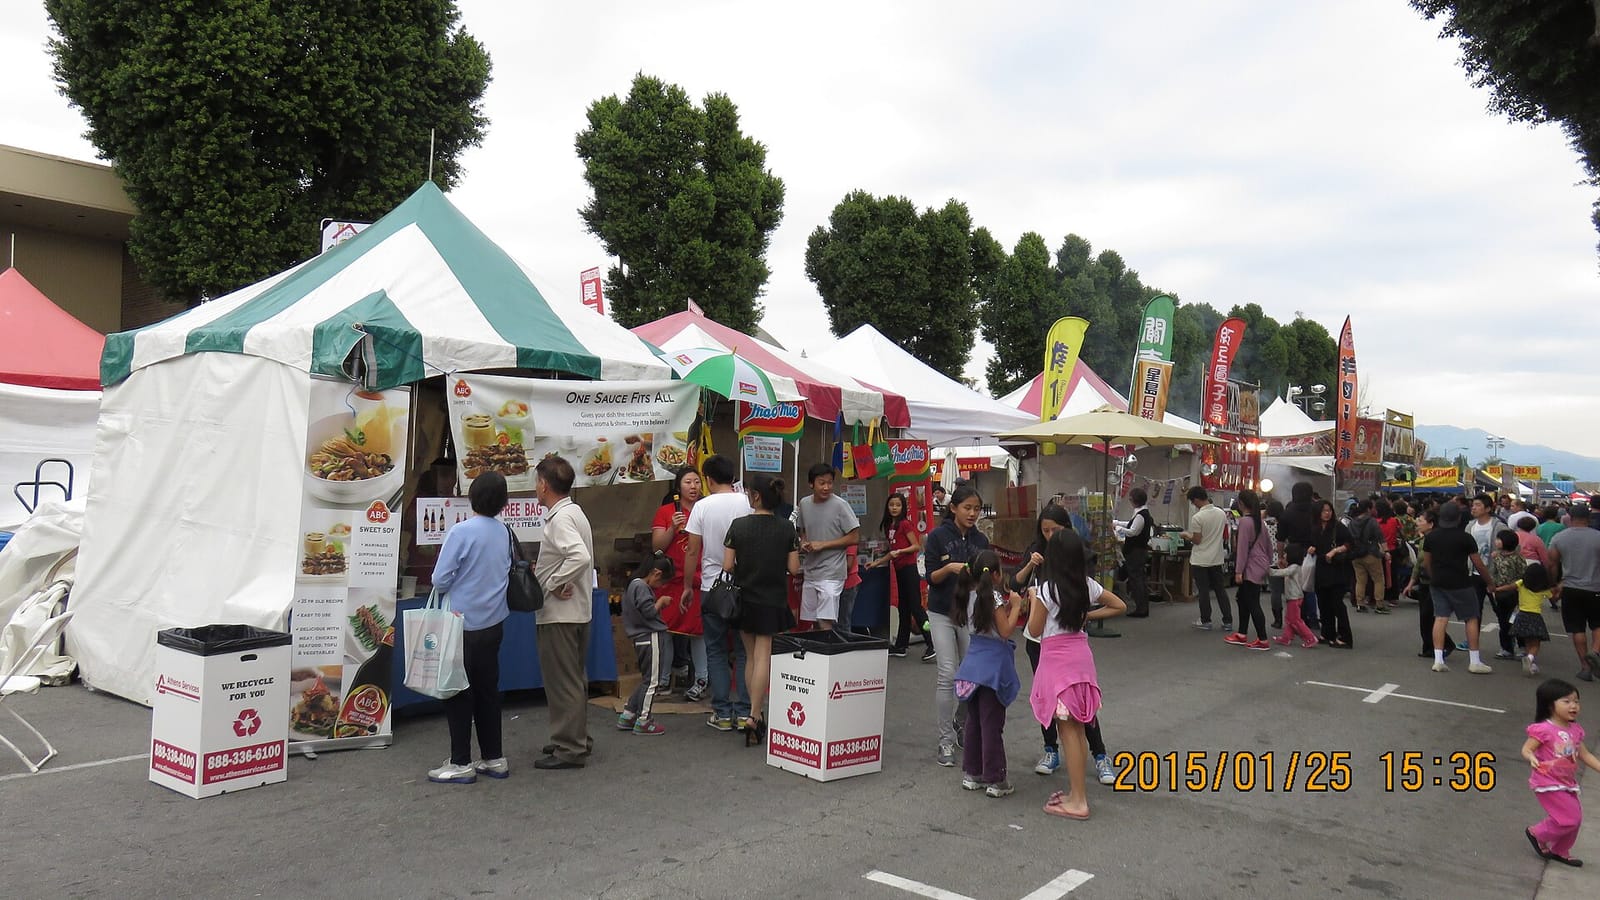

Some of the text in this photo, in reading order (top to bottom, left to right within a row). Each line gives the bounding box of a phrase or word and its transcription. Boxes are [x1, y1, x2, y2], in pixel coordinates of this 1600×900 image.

[456, 387, 469, 395] ABC
[566, 391, 675, 404] ONE SAUCE FITS ALL
[370, 510, 386, 519] ABC
[525, 502, 542, 516] BAG
[167, 676, 200, 693] Athens Services
[221, 677, 275, 690] WE RECYCLE
[781, 672, 816, 686] WE RECYCLE
[844, 678, 884, 688] Athens Services
[229, 689, 266, 701] FOR YOU
[785, 683, 810, 695] FOR YOU
[358, 697, 377, 709] ABC
[772, 732, 820, 756] 888-336-6100
[830, 738, 879, 757] 888-336-6100
[154, 743, 195, 769] 888-336-6100
[207, 744, 281, 770] 888-336-6100
[210, 762, 279, 781] www.athensservices.com
